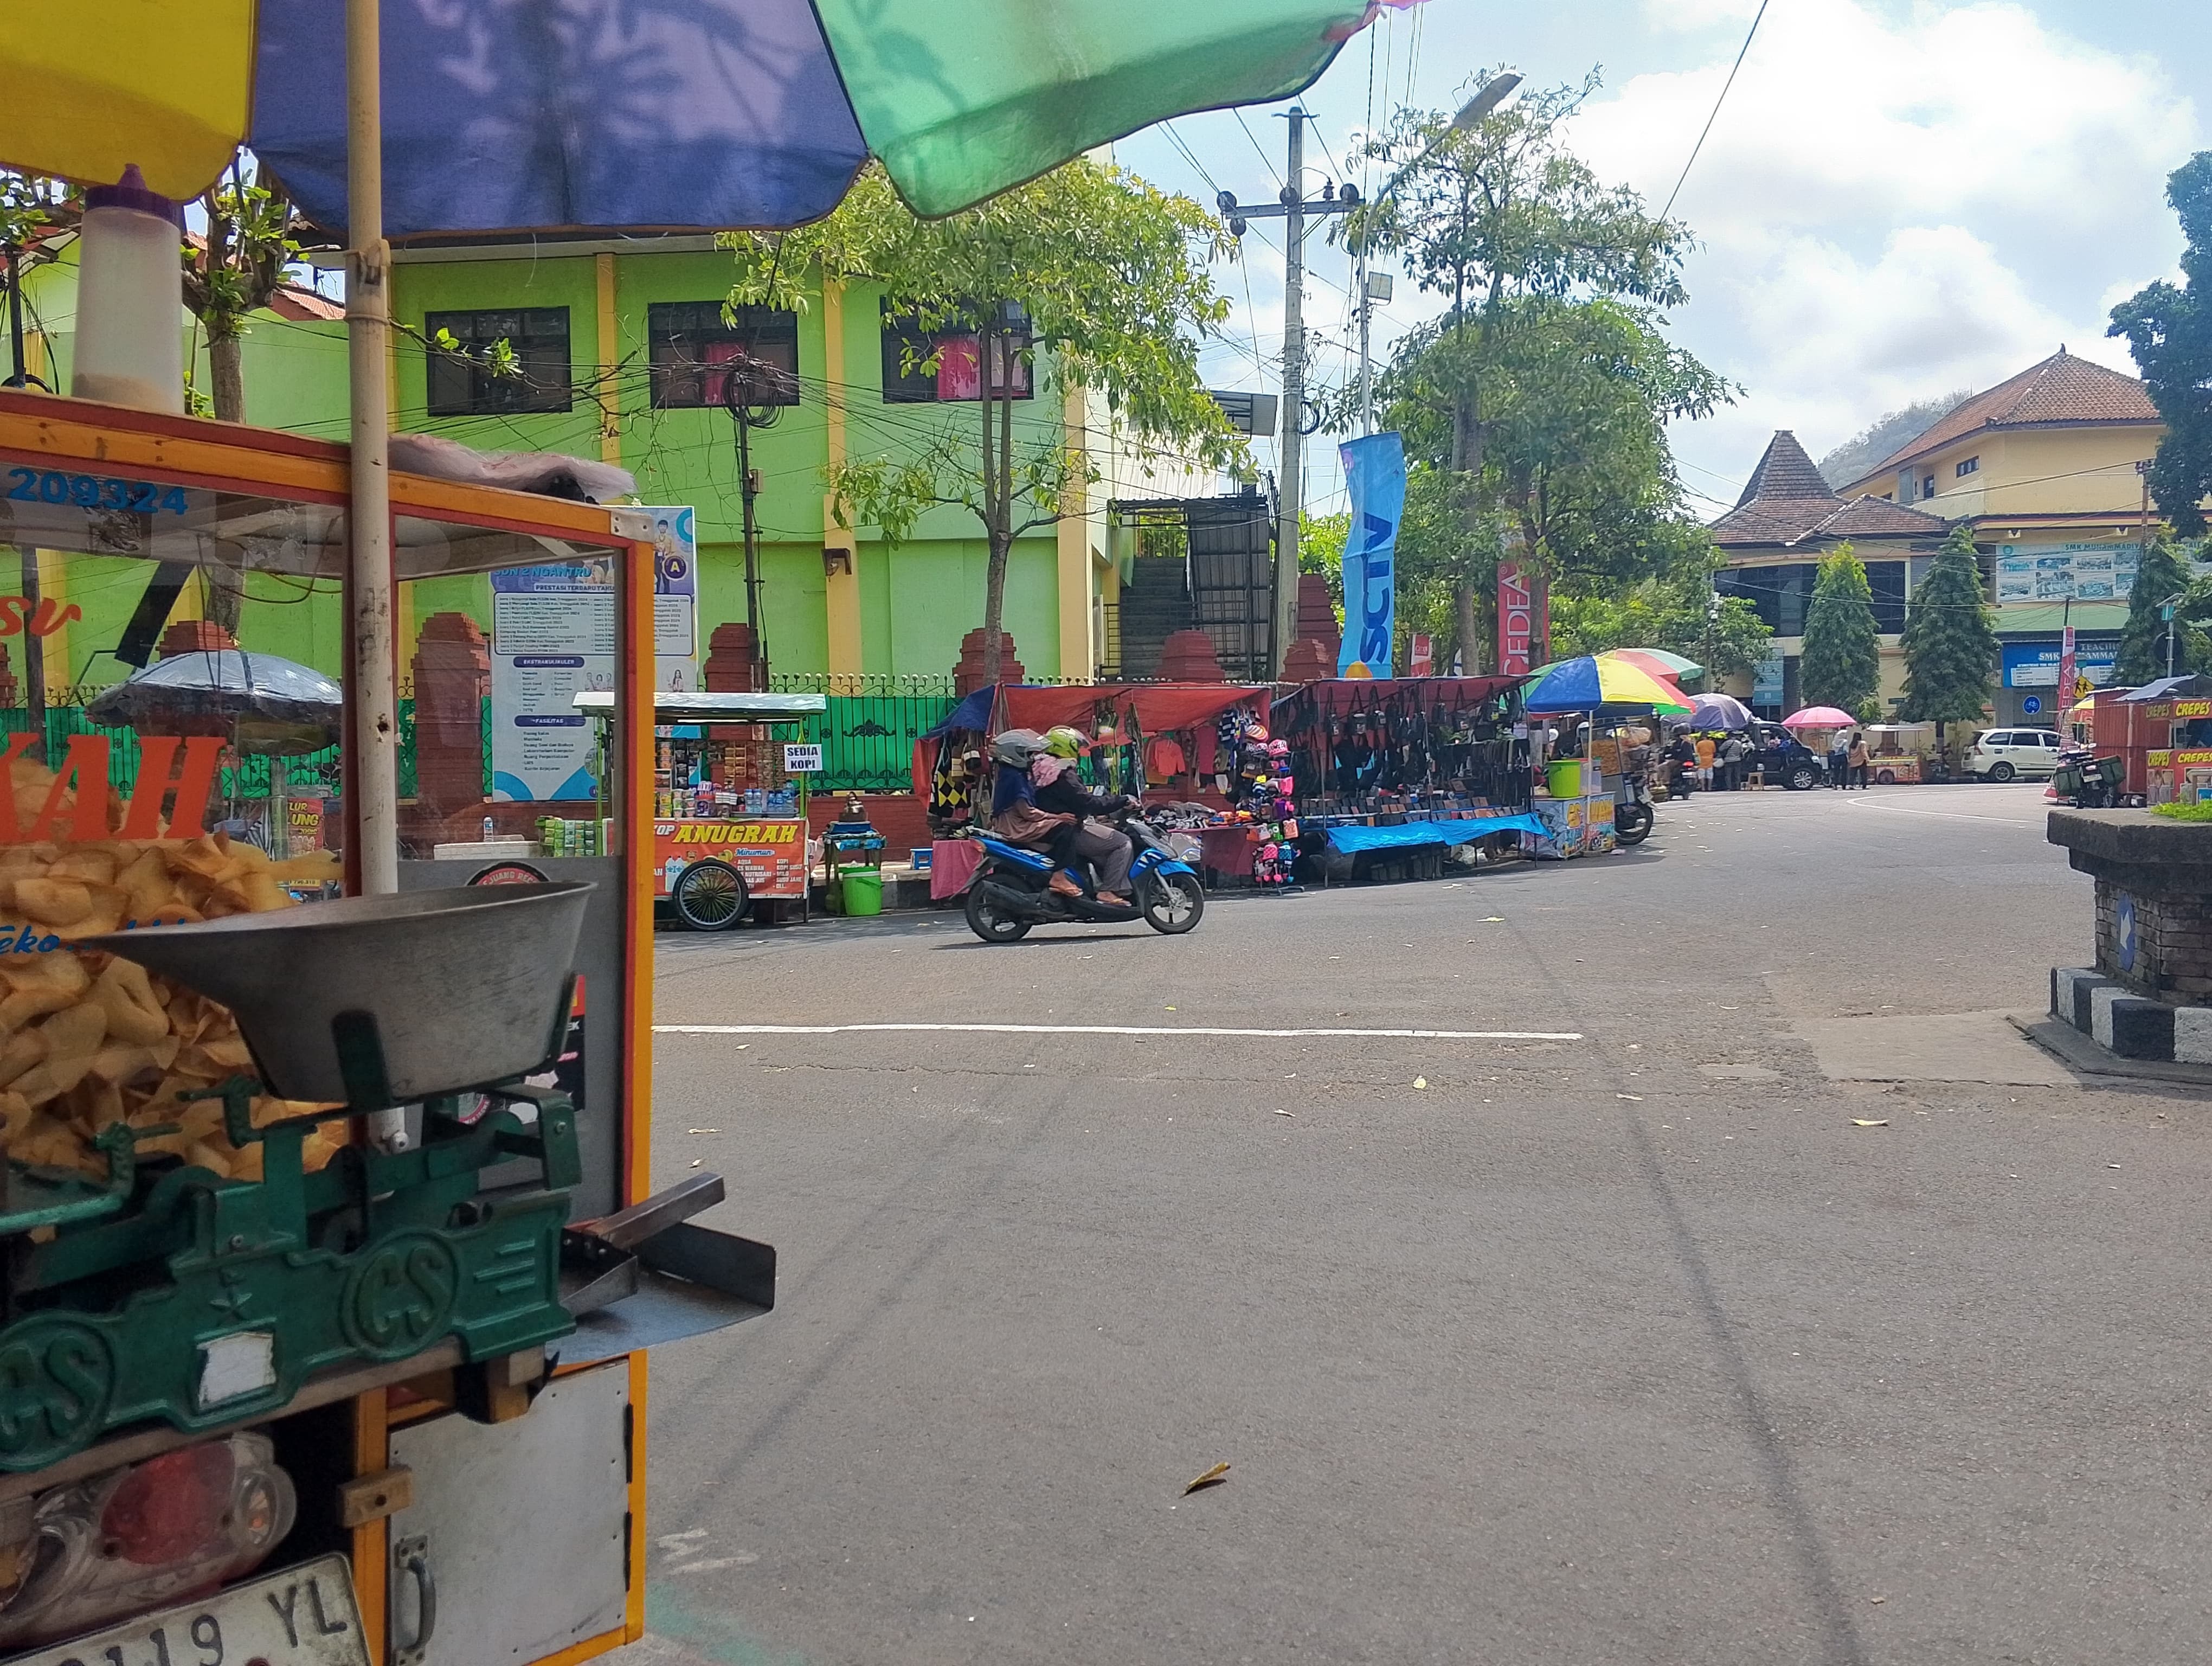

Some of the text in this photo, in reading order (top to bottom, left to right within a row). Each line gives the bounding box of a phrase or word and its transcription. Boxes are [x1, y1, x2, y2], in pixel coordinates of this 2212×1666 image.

[8, 468, 188, 515] 209324
[532, 567, 592, 578] NGANTRU
[670, 561, 680, 573] A
[1359, 512, 1392, 664] SCTV
[2061, 665, 2072, 708] EDEA
[2146, 704, 2171, 719] CREPES
[2176, 702, 2211, 716] CREPES
[787, 747, 818, 756] SEDIA
[2177, 752, 2212, 764] CREPES
[790, 759, 815, 769] KOPI
[2147, 751, 2171, 767] CREPES
[654, 825, 798, 843] OP ANUGRAH
[734, 848, 774, 856] Minuman
[59, 1577, 347, 1666] 19 YL
